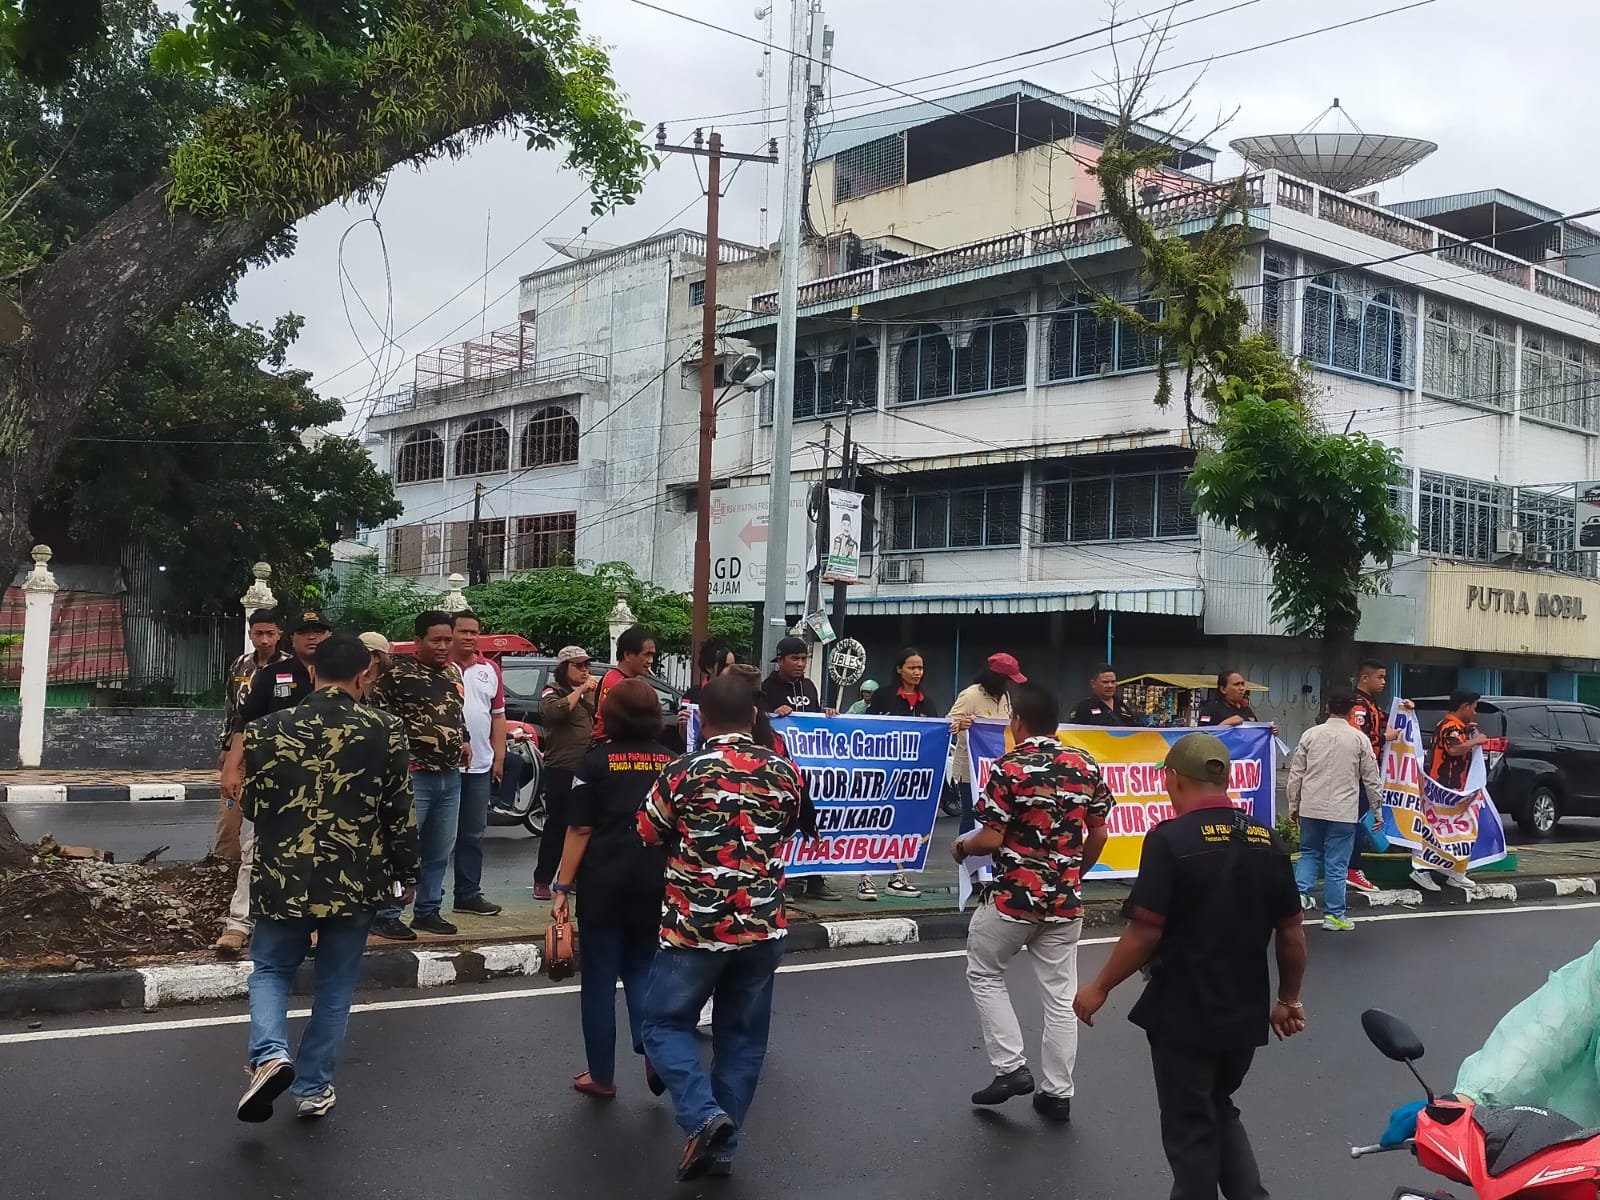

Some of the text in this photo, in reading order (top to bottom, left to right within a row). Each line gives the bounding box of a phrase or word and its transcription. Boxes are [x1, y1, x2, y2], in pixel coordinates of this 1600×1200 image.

[720, 581, 741, 594] JAM
[1466, 584, 1587, 621] PUTRA MOBIL
[788, 729, 832, 757] Tarik
[836, 734, 848, 757] &
[852, 732, 898, 759] Ganti
[609, 762, 631, 771] PEMUDA
[634, 762, 653, 771] MERGA
[844, 808, 892, 829] KARO
[797, 837, 917, 862] HASIBUAN
[1513, 1106, 1548, 1116] HONDA
